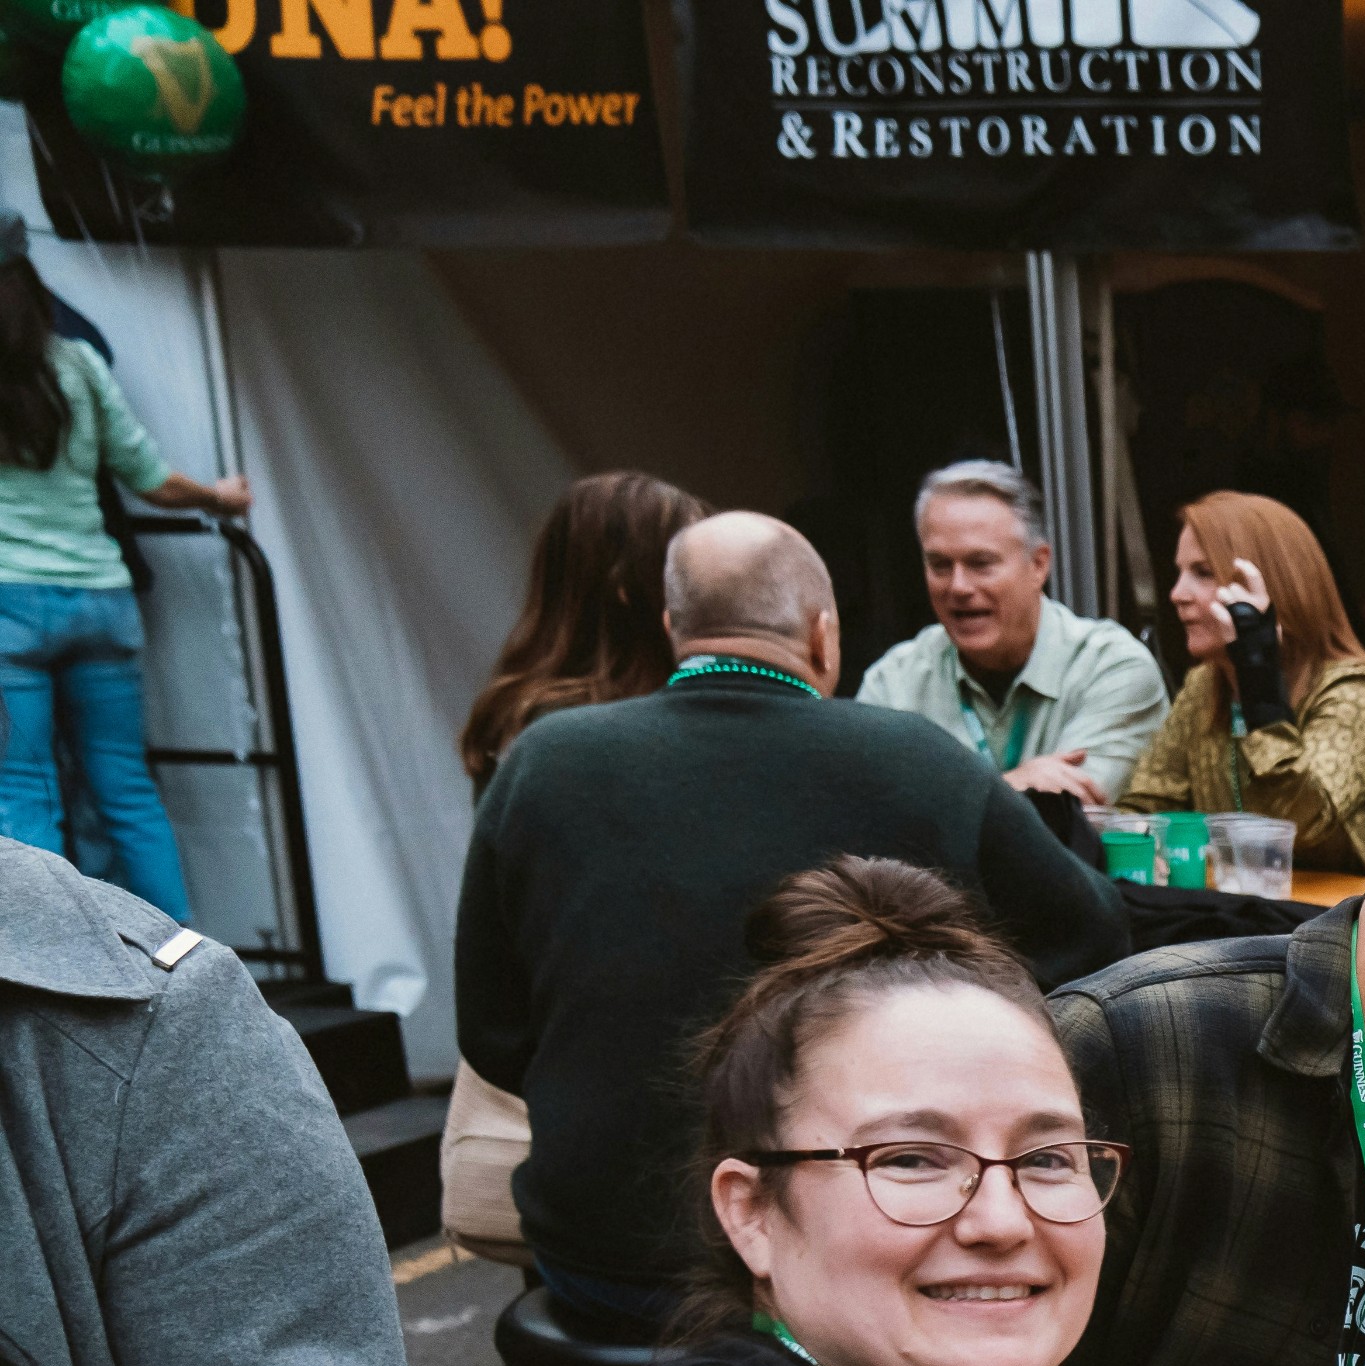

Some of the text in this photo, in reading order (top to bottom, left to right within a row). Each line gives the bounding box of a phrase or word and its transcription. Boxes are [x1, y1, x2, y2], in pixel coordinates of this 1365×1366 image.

[769, 50, 1262, 96] RECONSTRUCTION
[371, 83, 641, 127] Feel the Power
[776, 110, 1261, 158] & RESTORATION
